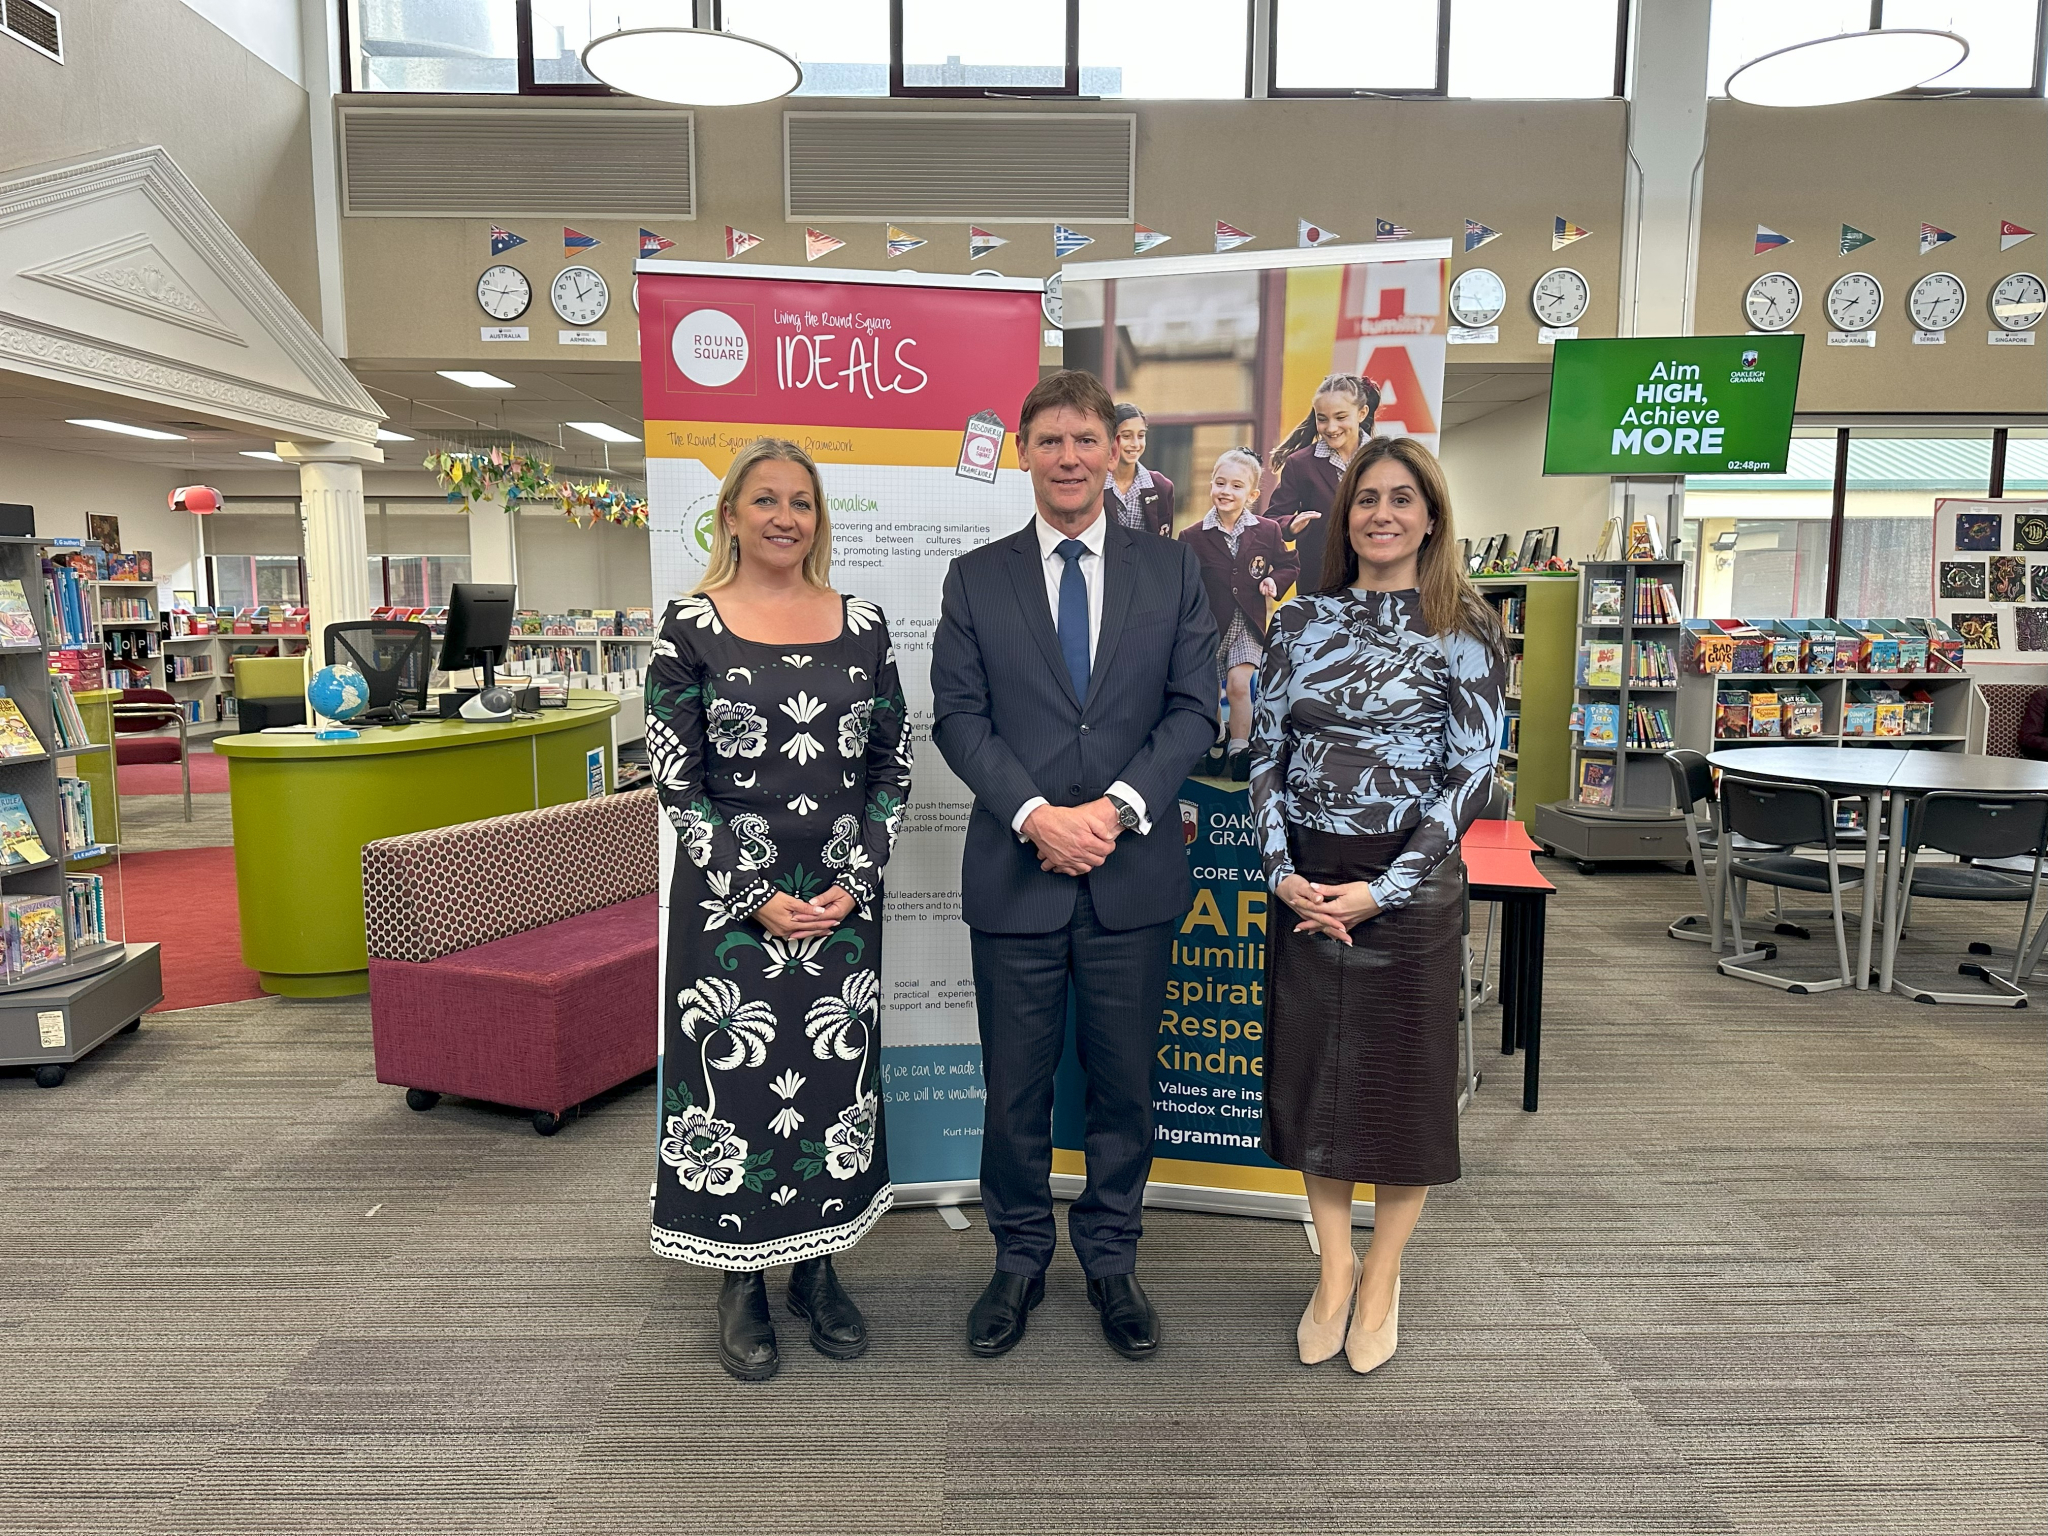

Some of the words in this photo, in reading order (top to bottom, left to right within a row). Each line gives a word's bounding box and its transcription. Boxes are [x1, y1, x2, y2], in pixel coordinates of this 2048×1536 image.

[774, 309, 801, 332] Living
[804, 311, 819, 327] the
[822, 312, 852, 328] Round
[855, 312, 892, 336] Square
[694, 334, 744, 348] ROUND
[694, 348, 744, 360] SQUARE
[776, 334, 928, 400] IDEALS
[1649, 360, 1700, 381] Aim
[1730, 370, 1766, 378] OAKLEIGH
[1361, 346, 1438, 434] A
[1636, 383, 1708, 405] HIGH,
[1620, 405, 1720, 425] Achieve
[971, 422, 1001, 440] DISCOVERY
[667, 432, 684, 447] The
[687, 433, 717, 447] Round
[1611, 427, 1725, 455] MORE
[1727, 460, 1770, 470] 02:48pm
[961, 465, 992, 478] FRAMEWORK
[875, 522, 892, 531] and
[894, 523, 942, 534] embracing
[943, 523, 990, 533] similarities
[875, 534, 914, 543] between
[926, 536, 961, 544] cultures
[973, 537, 990, 545] and
[843, 547, 889, 557] promoting
[891, 547, 921, 558] lasting
[848, 559, 885, 569] respect.
[161, 622, 169, 630] R
[895, 617, 905, 626] of
[104, 641, 112, 651] N
[121, 641, 131, 649] O
[138, 640, 146, 648] P
[894, 641, 901, 650] is
[904, 641, 924, 652] right
[1712, 643, 1732, 653] BAD
[1707, 653, 1732, 663] GUYS
[166, 664, 174, 673] S
[913, 710, 922, 719] of
[911, 733, 927, 742] and
[915, 801, 937, 811] push
[899, 824, 933, 833] capable
[934, 823, 943, 832] of
[1193, 866, 1239, 881] CORE
[1243, 868, 1266, 882] VA
[899, 890, 932, 899] leaders
[887, 902, 896, 910] to
[897, 902, 925, 910] others
[925, 902, 942, 910] and
[943, 902, 952, 910] to
[894, 913, 916, 921] them
[894, 979, 920, 988] social
[930, 979, 947, 987] and
[893, 990, 930, 1000] practical
[889, 1002, 922, 1011] support
[925, 1001, 941, 1009] and
[944, 1000, 974, 1009] benefit
[882, 1063, 891, 1084] If
[893, 1066, 908, 1077] we
[911, 1065, 931, 1077] can
[933, 1061, 946, 1076] be
[949, 1060, 976, 1076] made
[895, 1091, 911, 1102] we
[913, 1086, 929, 1102] will
[932, 1086, 945, 1100] be
[1158, 1081, 1208, 1097] Values
[1212, 1087, 1237, 1099] are
[1241, 1088, 1263, 1101] ins
[943, 1127, 962, 1136] Kurt
[1154, 1124, 1261, 1149] hgrammar
